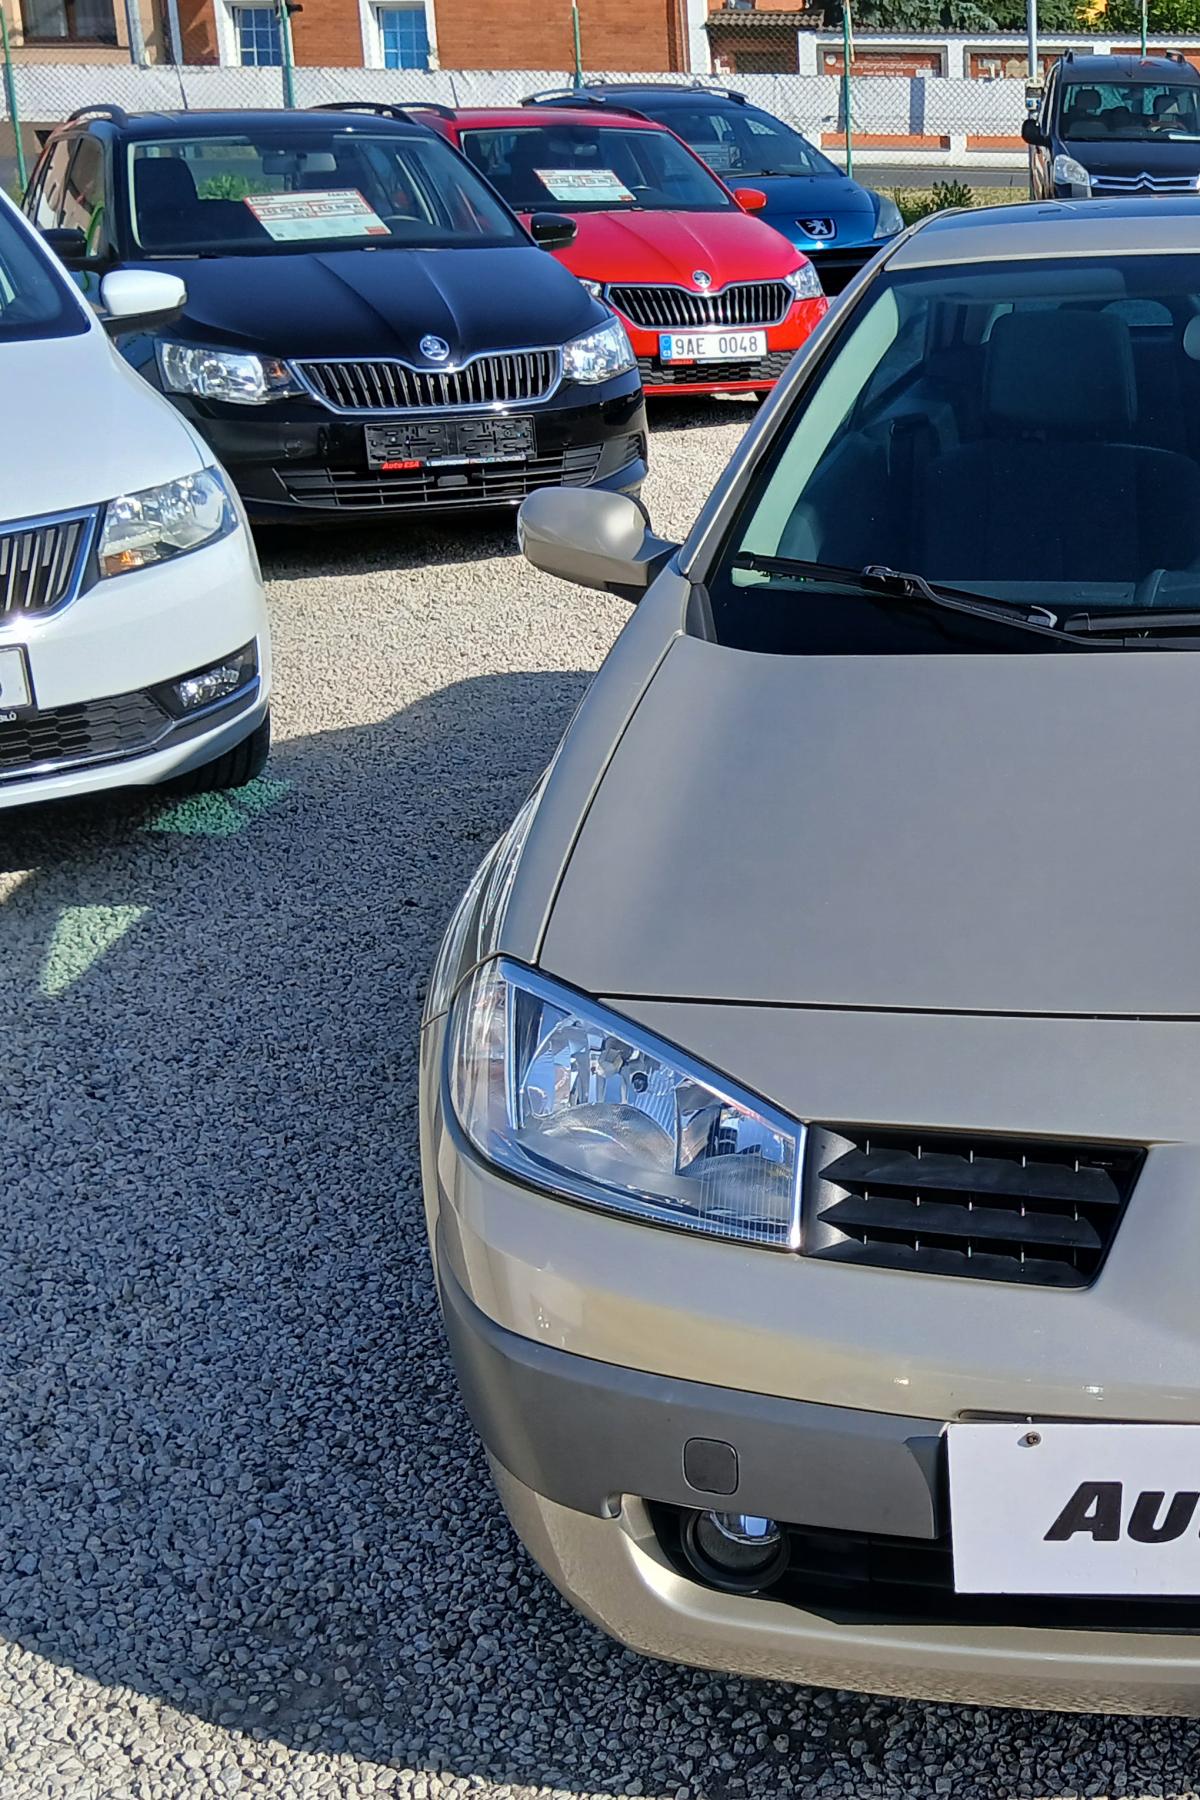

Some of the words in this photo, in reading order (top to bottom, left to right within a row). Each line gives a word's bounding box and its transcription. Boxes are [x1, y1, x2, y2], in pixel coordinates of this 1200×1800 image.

[675, 337, 707, 356] 9AE
[718, 335, 758, 354] 0048
[382, 461, 403, 470] Auto
[403, 460, 420, 469] ESA
